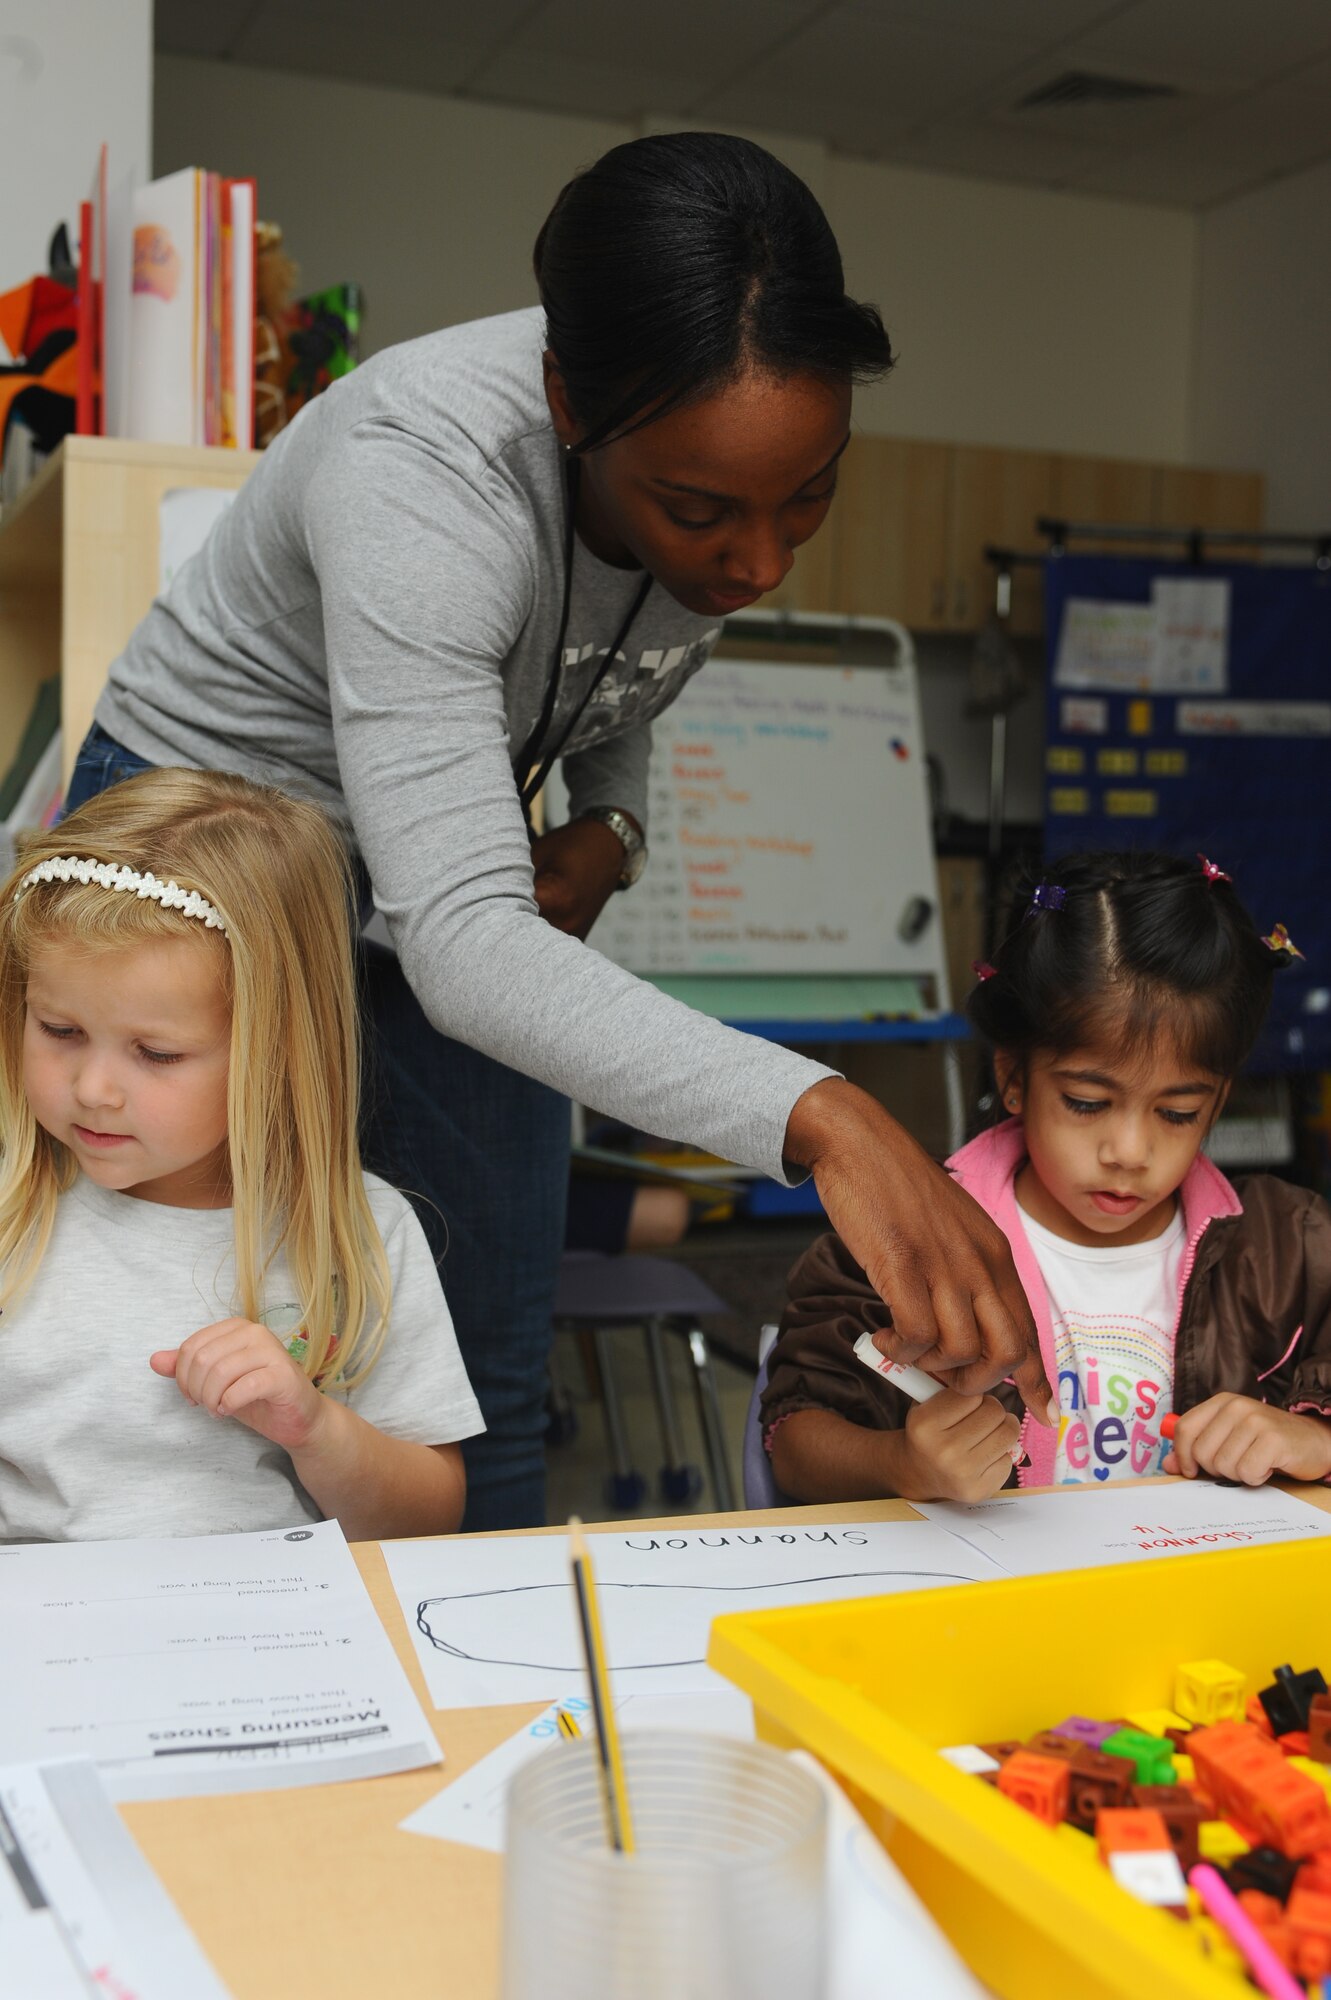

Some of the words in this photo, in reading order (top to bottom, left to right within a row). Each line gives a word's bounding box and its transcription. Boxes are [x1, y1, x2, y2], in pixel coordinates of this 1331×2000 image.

[203, 1580, 231, 1588] long
[236, 1579, 263, 1587] how
[237, 1587, 299, 1597] measured
[216, 1634, 246, 1642] long
[251, 1633, 280, 1641] how
[299, 1629, 324, 1638] This
[335, 1637, 352, 1645] 2.
[253, 1642, 319, 1654] measured
[320, 1688, 347, 1698] This
[231, 1697, 264, 1707] long
[269, 1694, 300, 1704] how
[270, 1703, 342, 1717] measured
[240, 1709, 381, 1734] Measuring
[147, 1726, 232, 1741] Shoes
